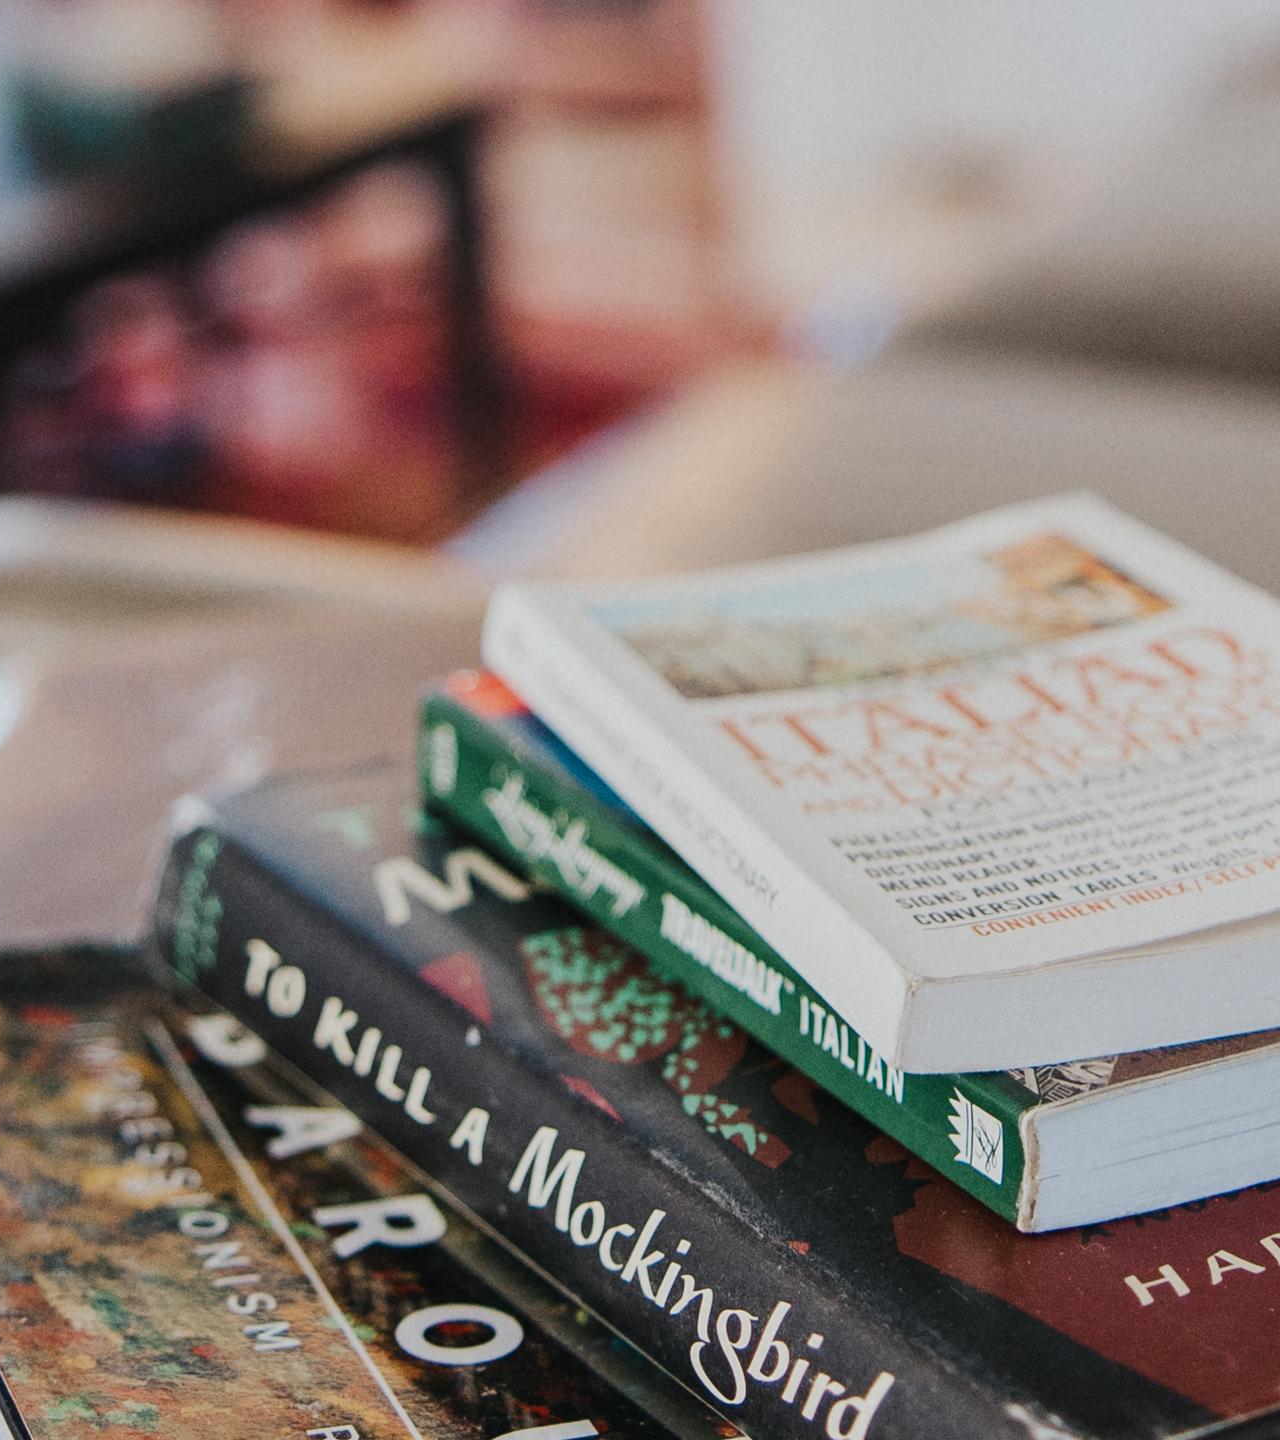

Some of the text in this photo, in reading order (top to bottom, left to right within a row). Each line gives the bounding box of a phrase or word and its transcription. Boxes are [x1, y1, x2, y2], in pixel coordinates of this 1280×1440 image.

[846, 825, 1027, 864] PRONUNCIATION
[864, 850, 998, 879] DICTIONARY
[878, 874, 948, 894] MENU
[951, 857, 1040, 884] READER
[895, 889, 967, 910] SIGNS
[972, 880, 1019, 899] AND
[1024, 857, 1121, 888] NOTICES
[911, 889, 1063, 926] CONVERSION
[1068, 869, 1158, 898] TABLES
[971, 897, 1118, 937] CONVENIENT
[246, 938, 307, 1018] TO
[313, 996, 437, 1125] KILL
[449, 1107, 490, 1166] A
[799, 995, 905, 1105] ITALIAN
